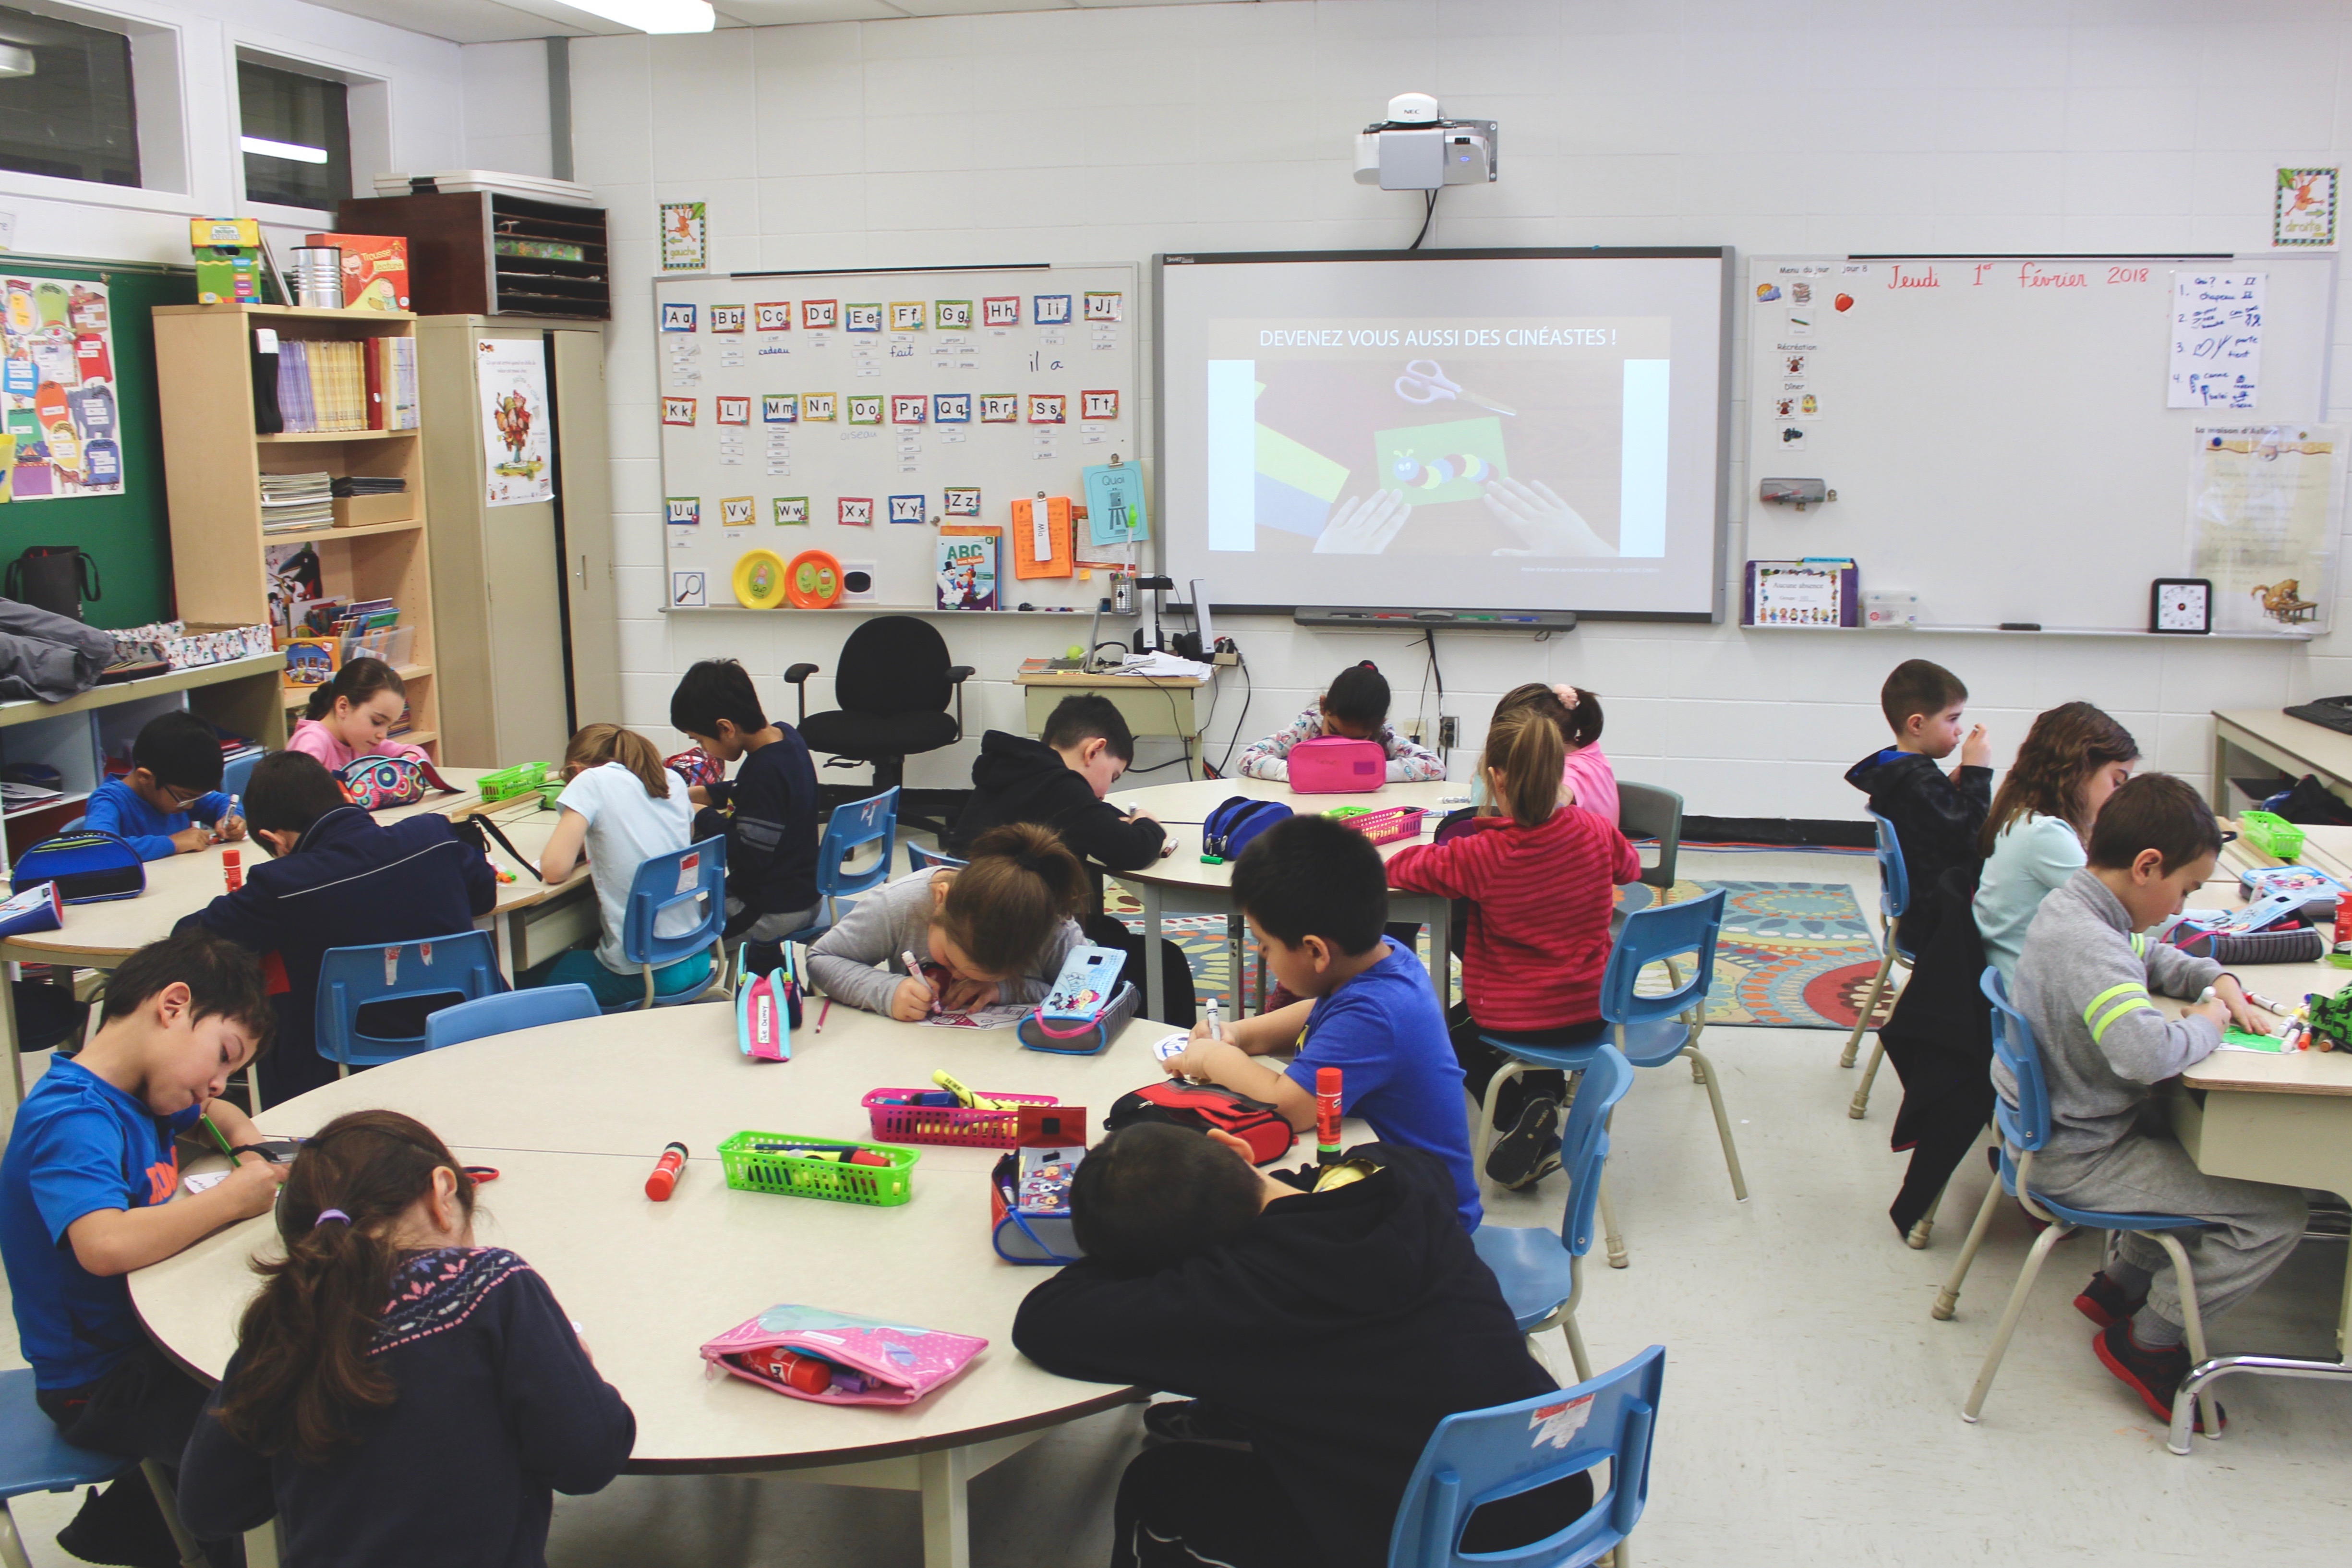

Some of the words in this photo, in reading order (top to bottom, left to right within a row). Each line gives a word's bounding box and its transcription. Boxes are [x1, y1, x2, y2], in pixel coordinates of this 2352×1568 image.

[2285, 219, 2322, 232] droite
[361, 249, 392, 262] Trousse
[374, 261, 403, 271] lecture
[1813, 265, 1830, 275] jour
[1842, 264, 1860, 274] jour
[1888, 265, 1941, 289] Jeudi
[2018, 262, 2088, 288] février
[2107, 266, 2149, 285] 2018
[1260, 329, 1344, 347] DEVENEZ
[1348, 330, 1399, 346] VOUS
[1405, 329, 1459, 346] AUSSI
[1465, 330, 1501, 346] DES
[1506, 326, 1606, 346] CINÉASTES
[1611, 328, 1616, 345] !
[759, 346, 790, 355] cadeau
[889, 344, 914, 357] fait
[1777, 342, 1817, 351] Récréation
[1030, 350, 1039, 372] il
[1050, 360, 1063, 370] a
[1784, 382, 1805, 390] Dîner
[840, 430, 878, 441] oiseau
[1102, 475, 1125, 486] Quoi
[947, 544, 982, 560] ABC
